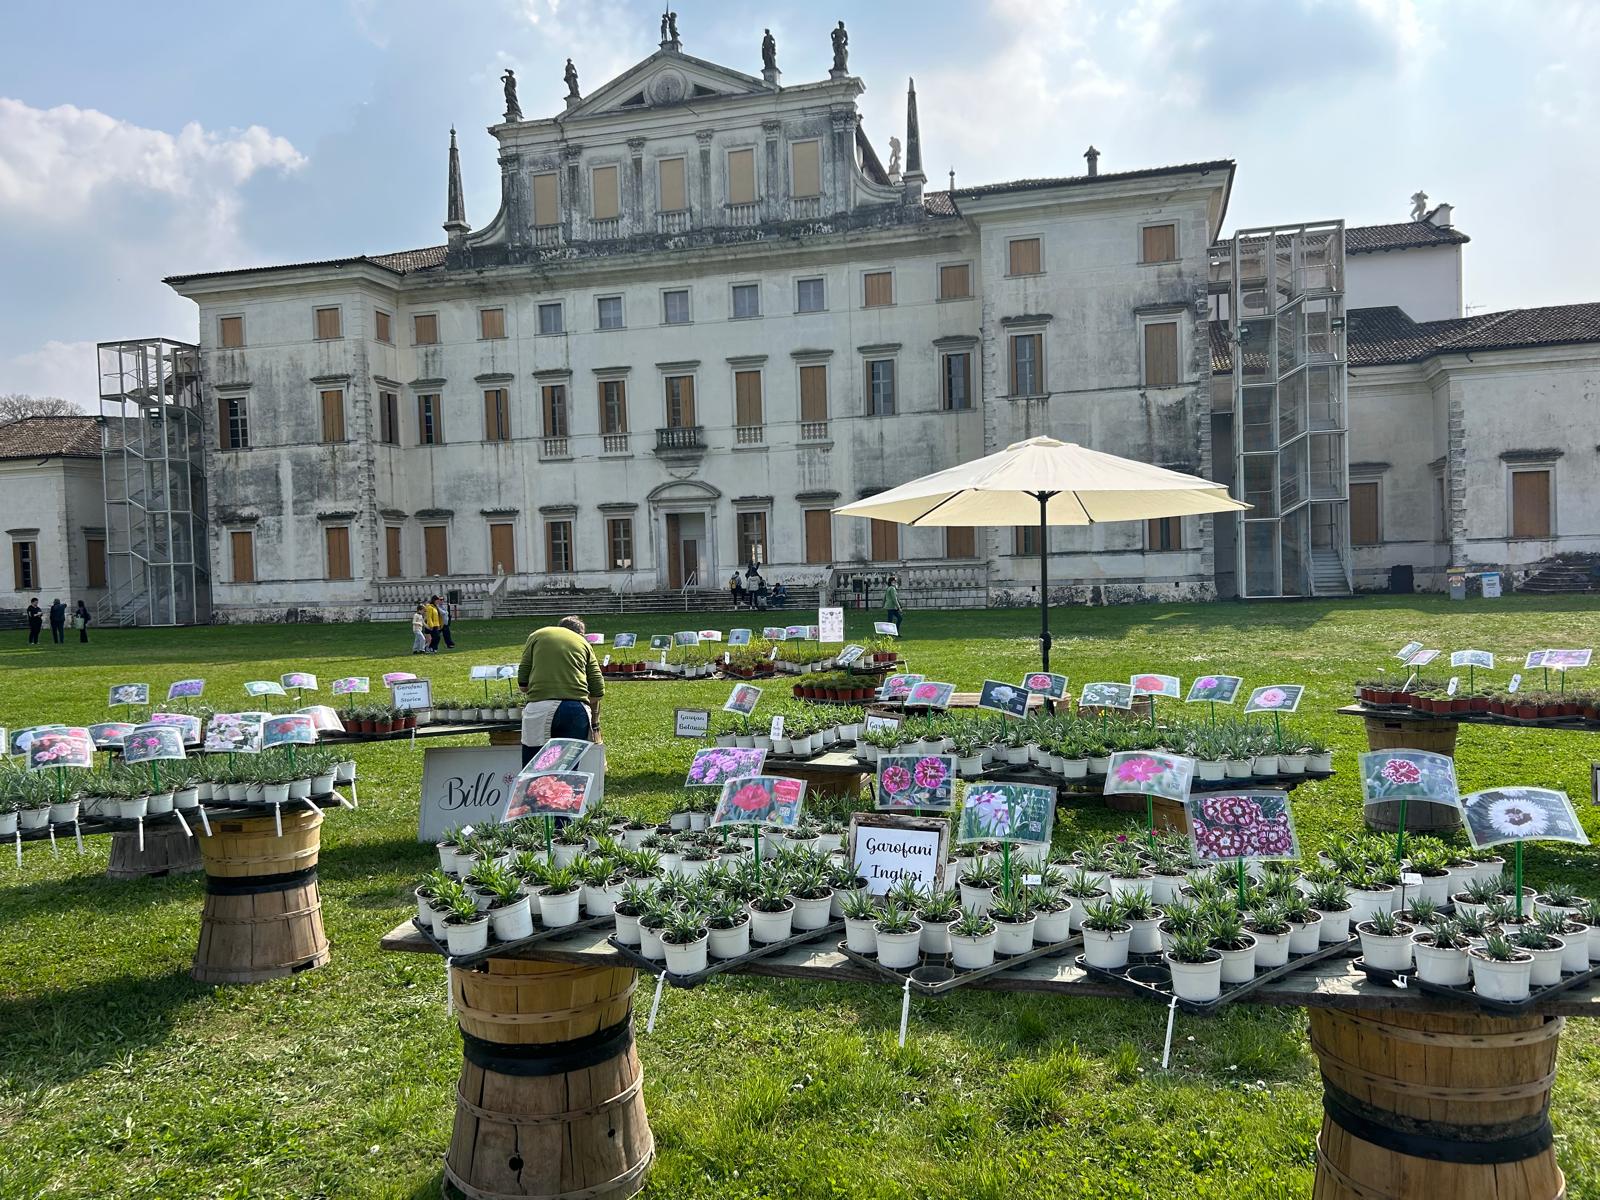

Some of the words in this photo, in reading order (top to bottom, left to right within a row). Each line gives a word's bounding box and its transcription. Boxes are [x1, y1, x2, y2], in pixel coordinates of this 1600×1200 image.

[438, 772, 501, 811] Billo
[866, 837, 932, 859] Garofani
[870, 864, 922, 884] Inglesi
